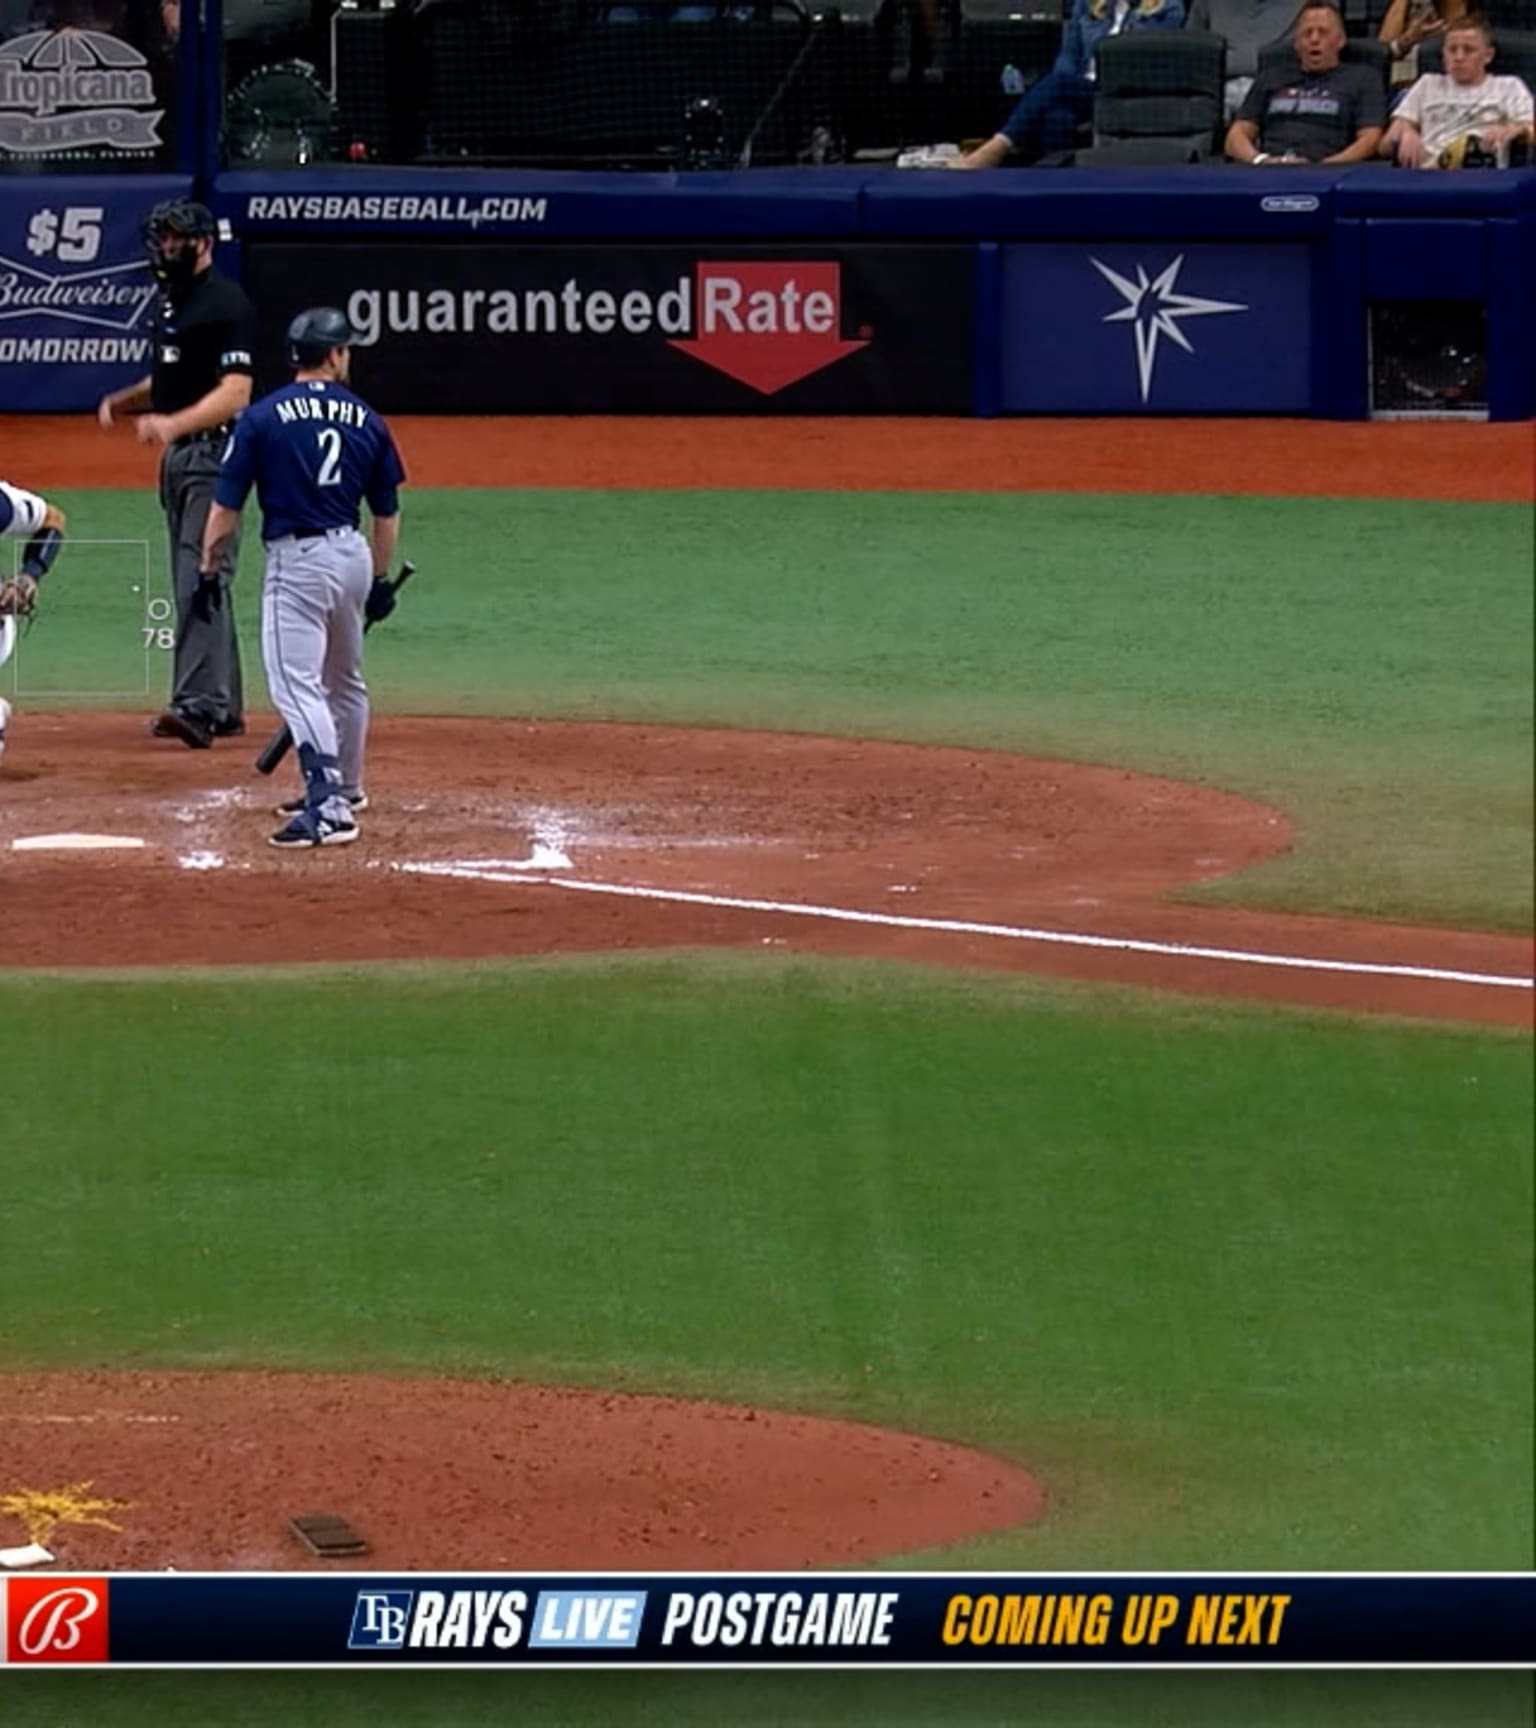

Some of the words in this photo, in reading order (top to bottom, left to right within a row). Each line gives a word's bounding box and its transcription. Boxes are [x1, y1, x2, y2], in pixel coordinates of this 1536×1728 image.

[26, 207, 104, 262] $5
[247, 196, 547, 226] RAYSBASEBALL.COM
[348, 277, 692, 345] guaranteed
[703, 278, 835, 333] Rate
[275, 397, 368, 428] MURPHY
[317, 427, 343, 487] 2
